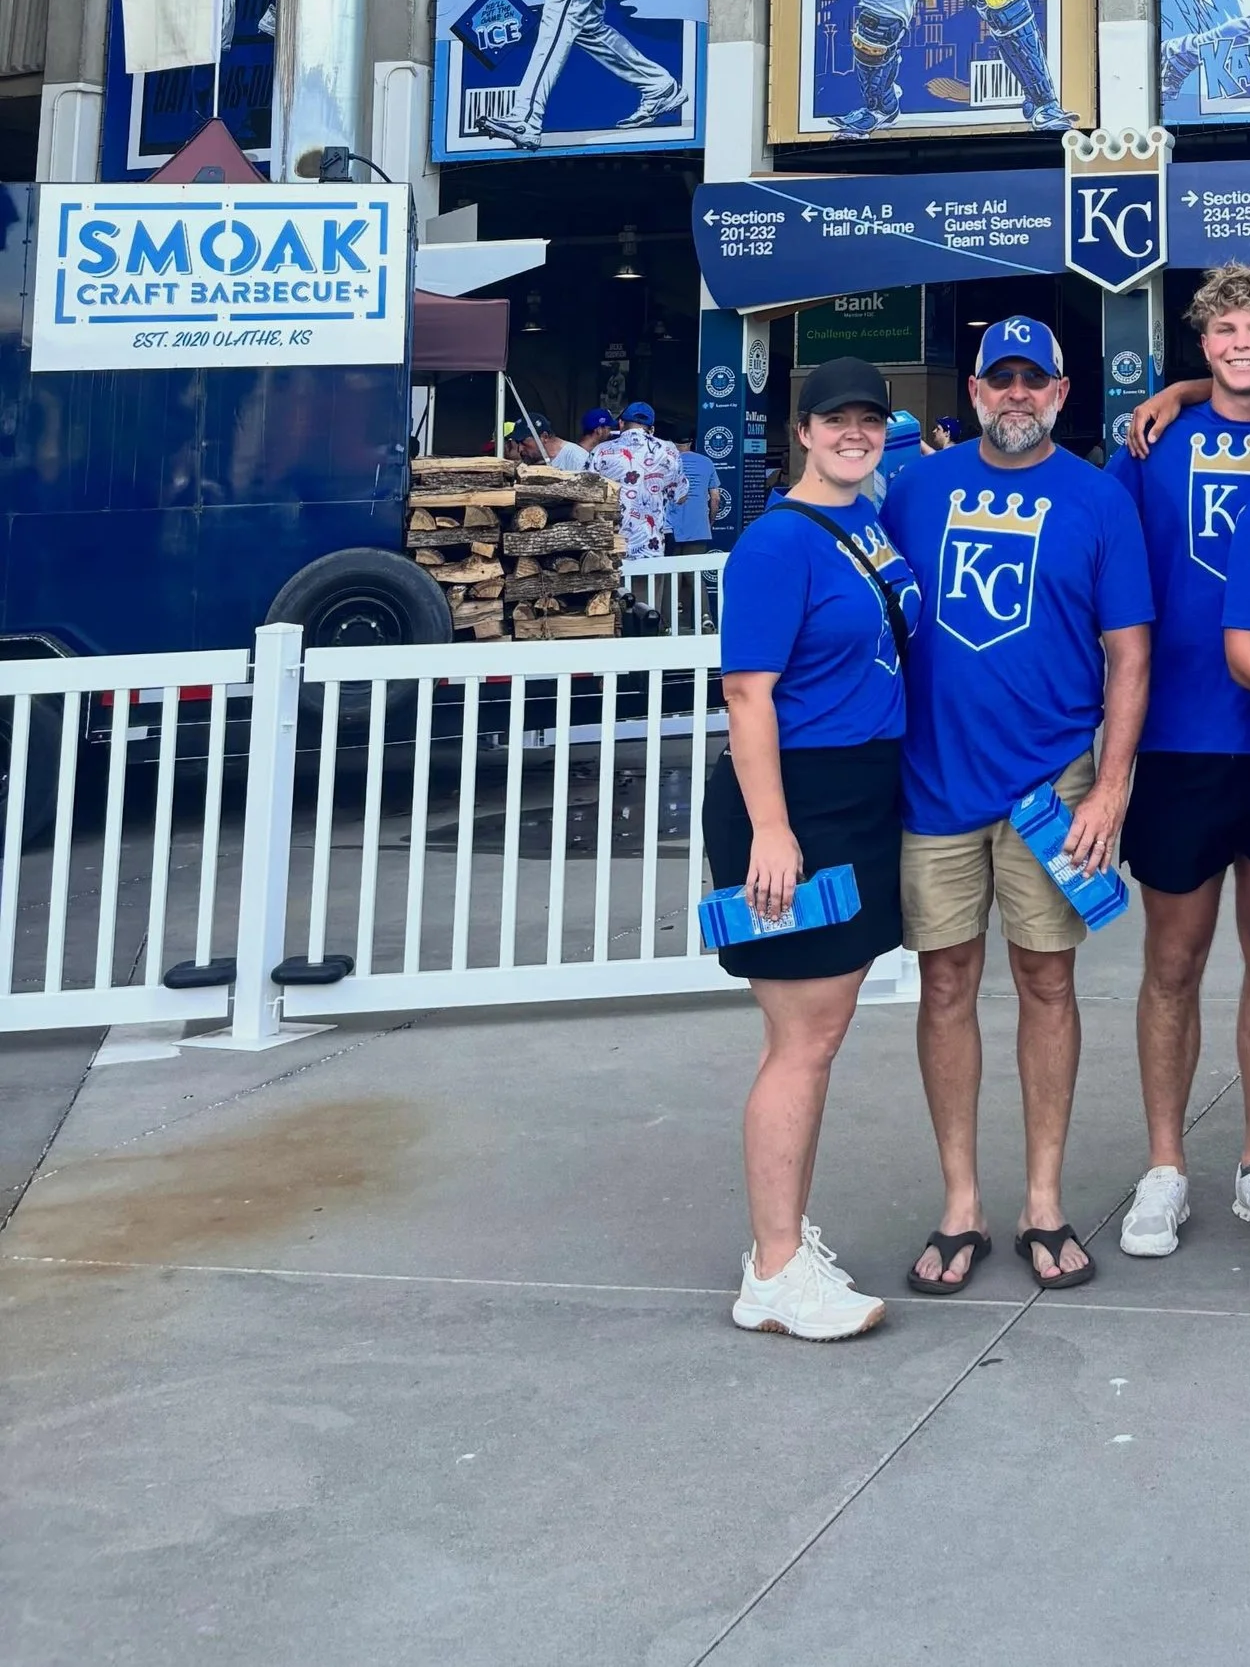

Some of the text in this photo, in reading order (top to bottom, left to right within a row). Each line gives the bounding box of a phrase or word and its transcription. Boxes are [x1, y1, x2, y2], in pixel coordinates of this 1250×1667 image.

[498, 5, 511, 14] THE
[504, 10, 514, 19] ON
[476, 18, 522, 50] ICE
[823, 205, 893, 221] Gate A, B
[945, 200, 1006, 216] First Aid
[721, 210, 785, 225] Sections
[945, 215, 1052, 232] Guest Services
[1078, 187, 1153, 258] KC
[720, 226, 776, 241] 201-232
[822, 221, 914, 236] Hall of Fame
[944, 231, 1029, 247] Team Store
[77, 219, 371, 278] SMOAK
[720, 242, 773, 256] 101-132
[76, 280, 369, 305] CRAFT BARBECUE+
[835, 292, 884, 311] Bank
[133, 329, 313, 348] EST. 2020 OLATHE, KS
[806, 326, 913, 340] Challenge Accepted.
[1004, 319, 1031, 343] KC
[1198, 484, 1247, 537] K
[946, 541, 1024, 621] KC
